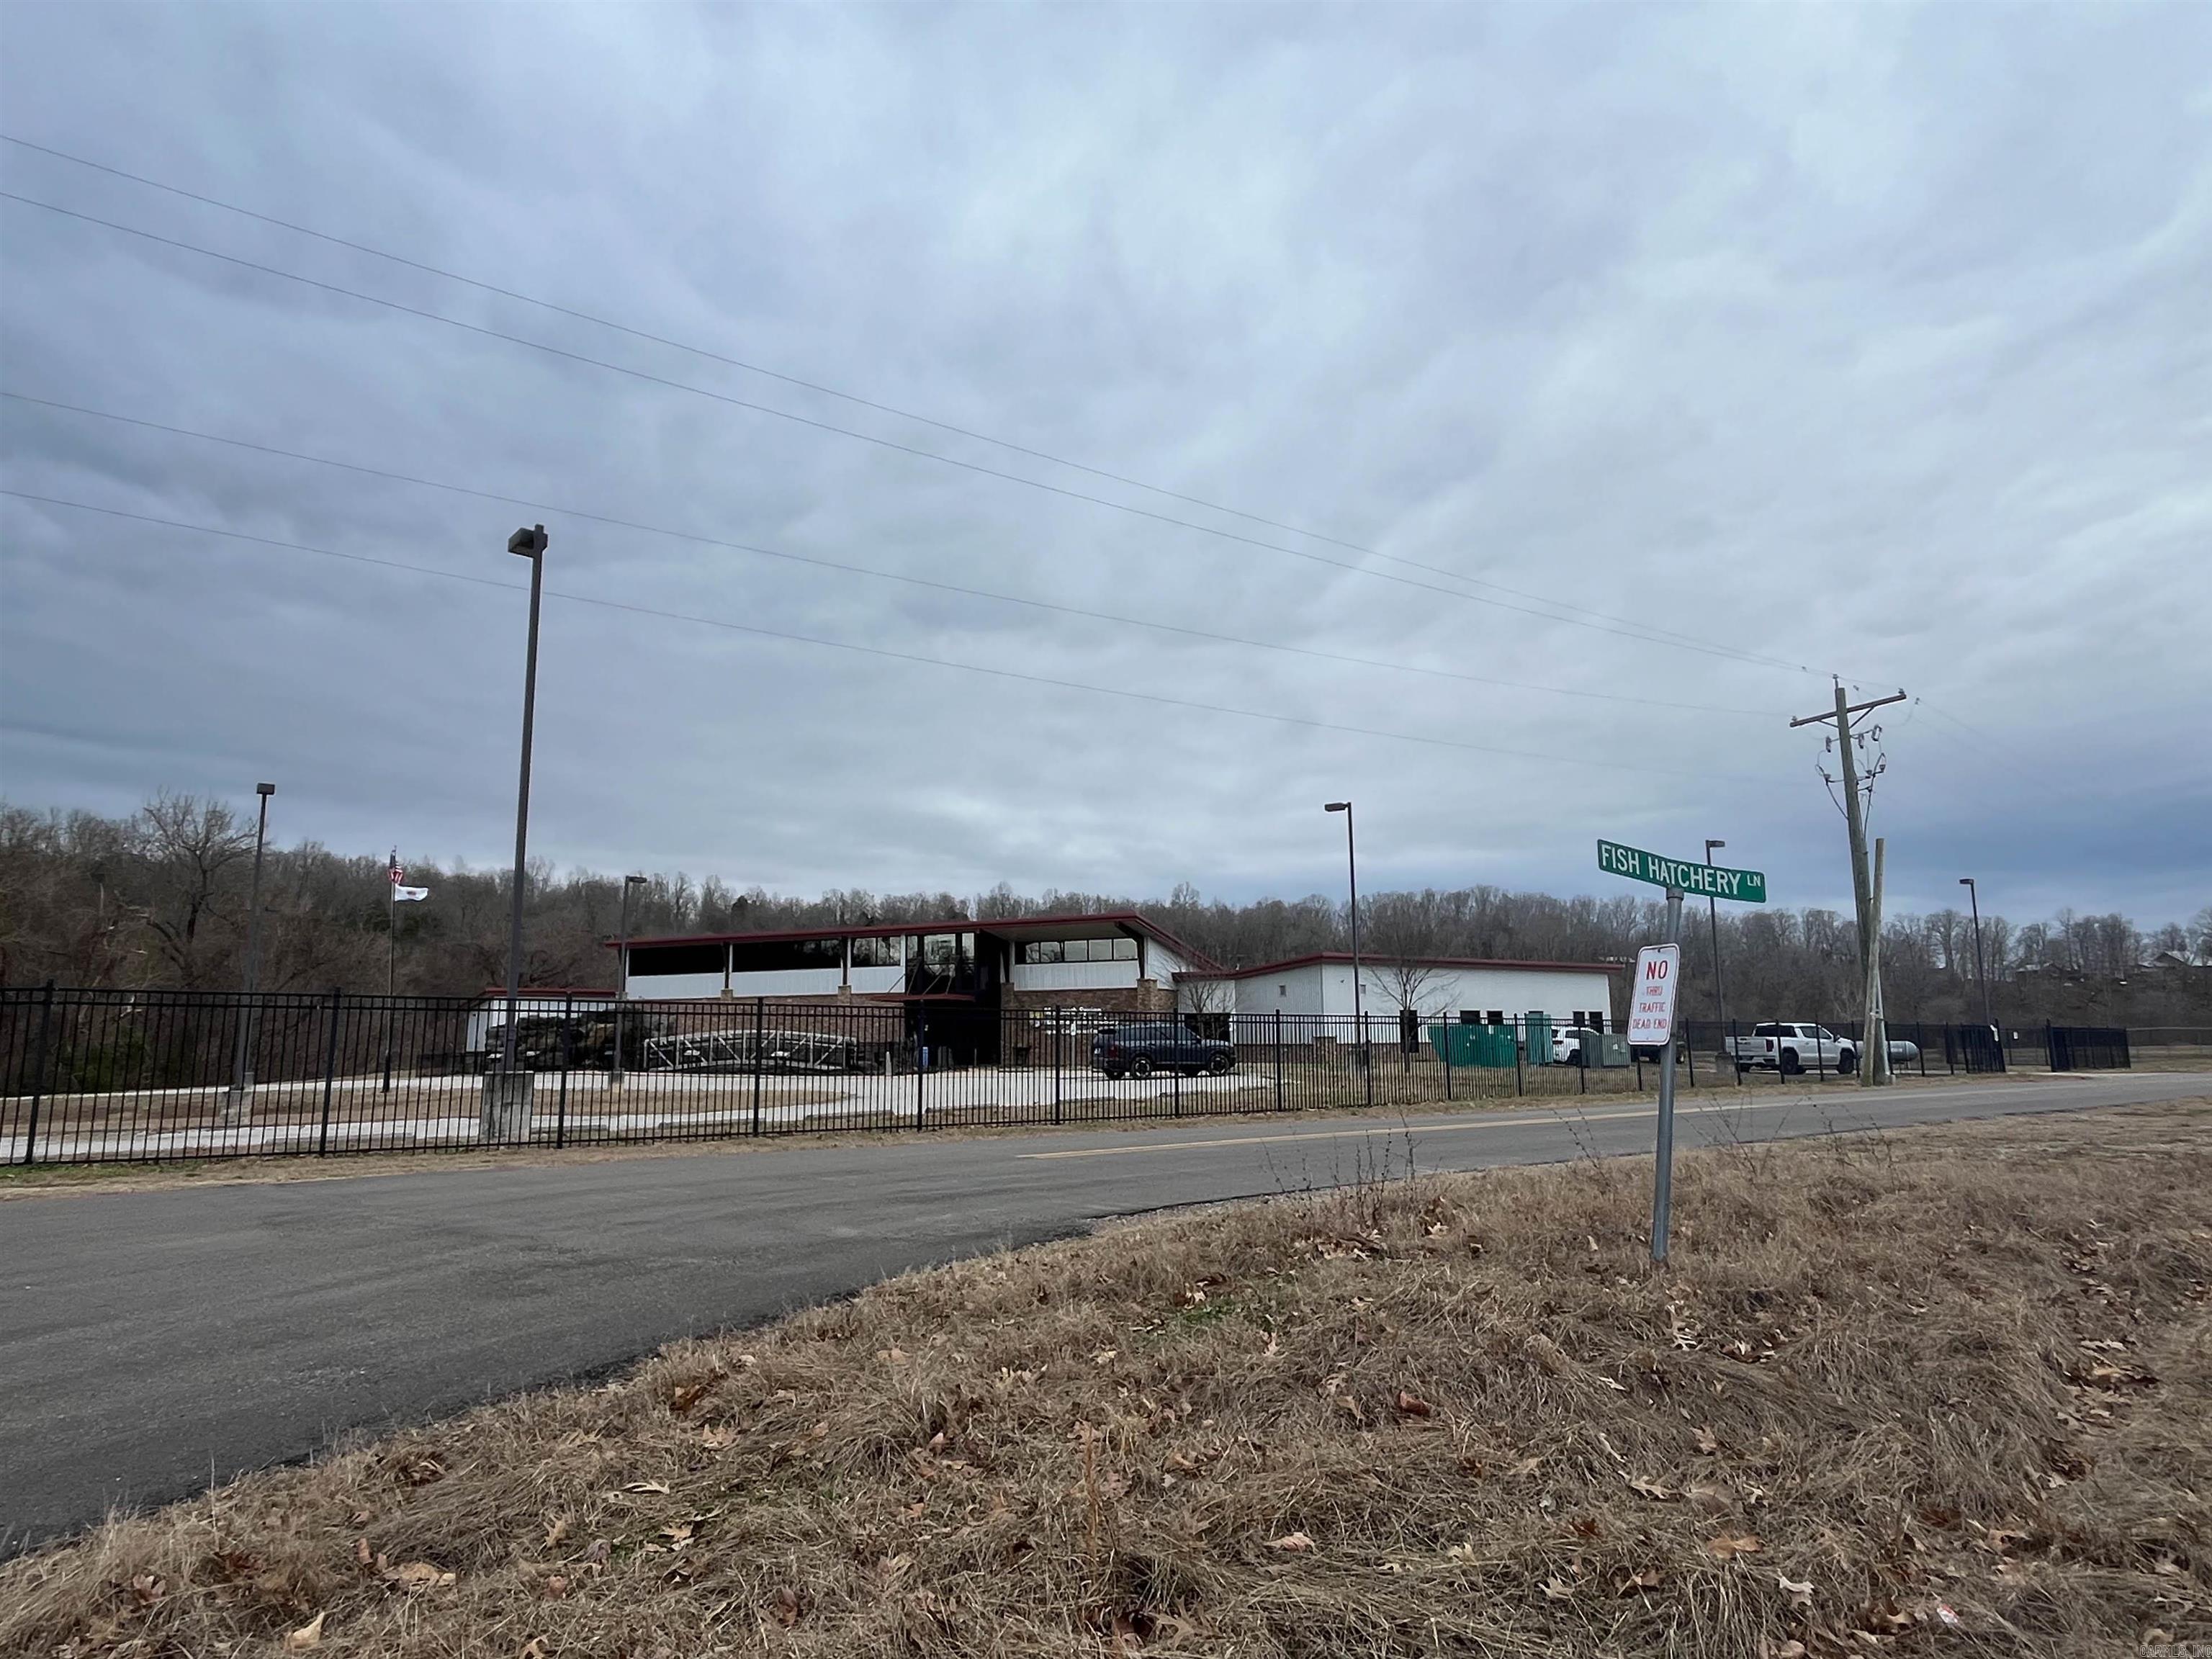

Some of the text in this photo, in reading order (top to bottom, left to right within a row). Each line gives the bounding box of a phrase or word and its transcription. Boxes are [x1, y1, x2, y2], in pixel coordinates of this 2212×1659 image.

[1601, 844, 1761, 895] FISH HATCHERY LN
[1646, 960, 1668, 980] NO
[1646, 986, 1663, 996] THRU
[1639, 1002, 1665, 1013] TRAFFIC
[1632, 1018, 1667, 1029] DEAD END
